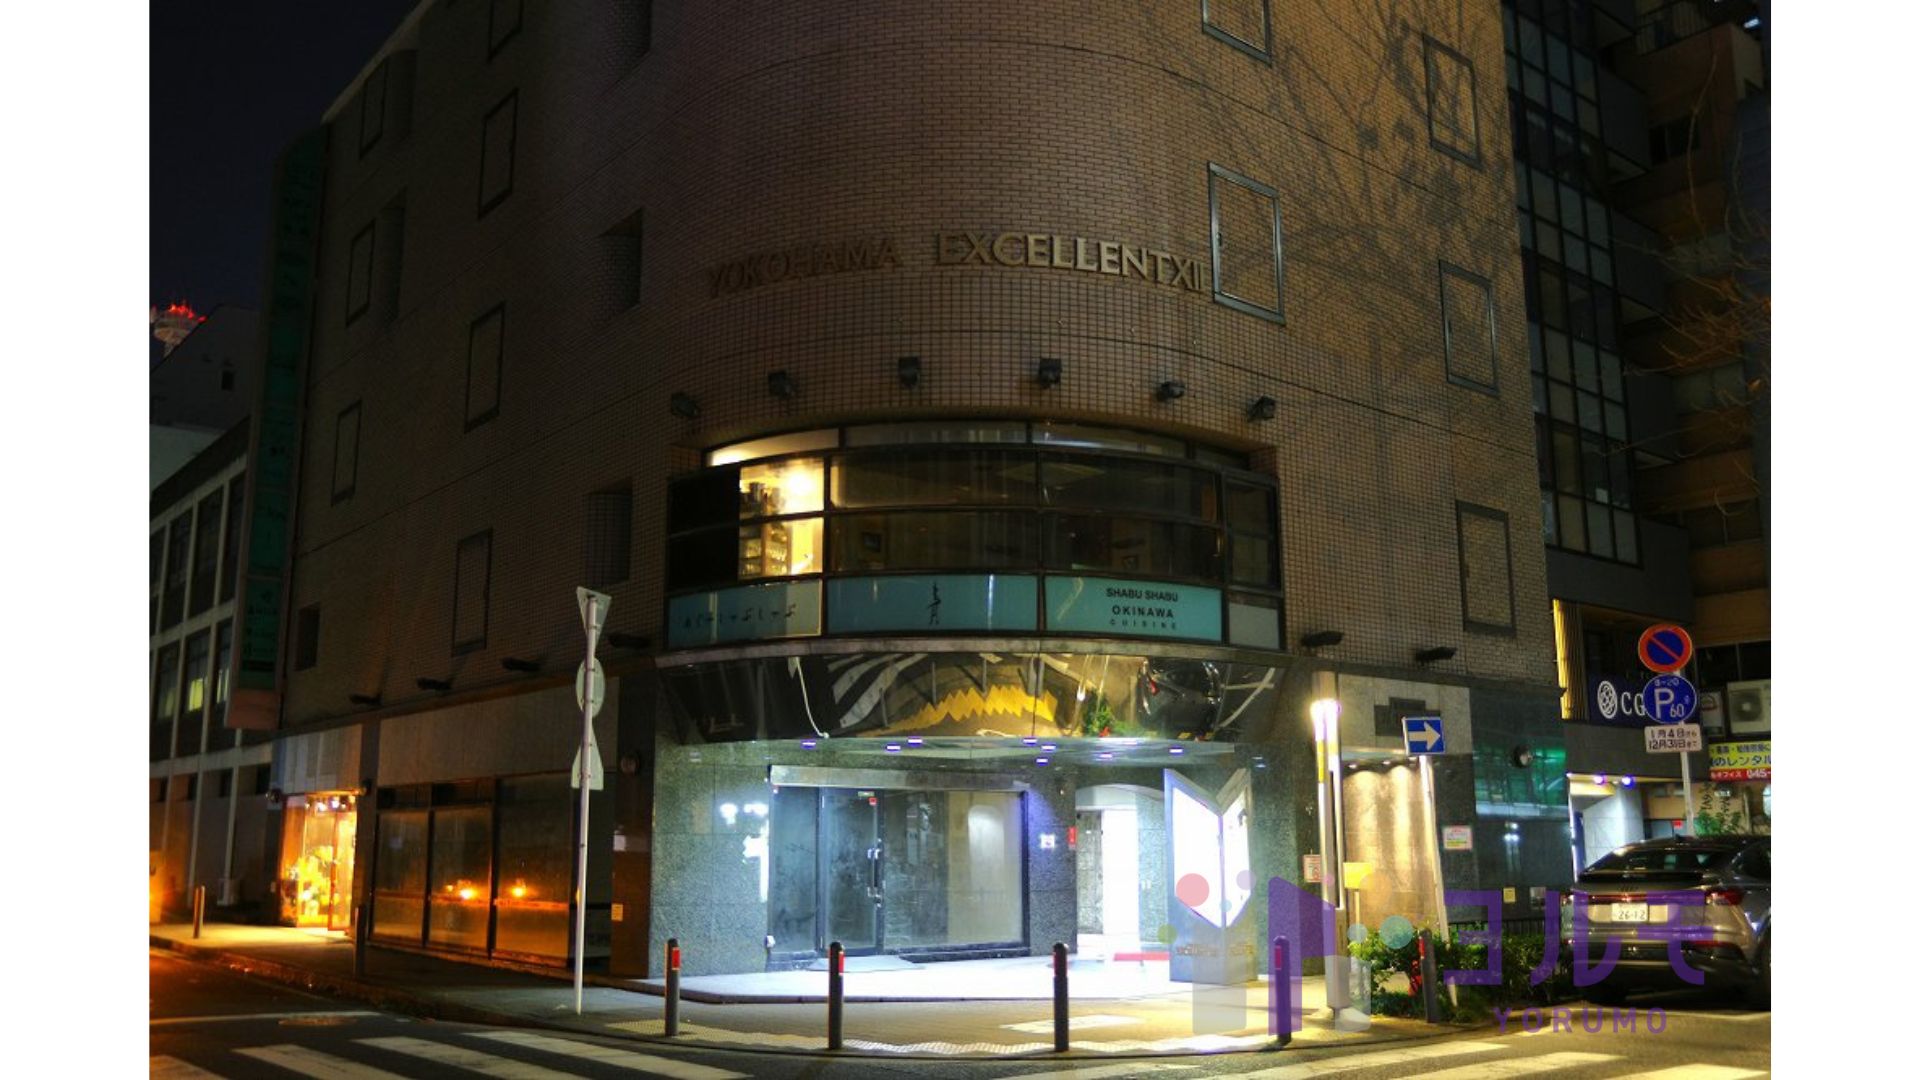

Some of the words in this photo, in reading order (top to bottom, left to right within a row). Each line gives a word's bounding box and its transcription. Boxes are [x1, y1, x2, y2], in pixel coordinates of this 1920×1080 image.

[707, 238, 901, 297] YOKOHAMA
[1106, 588, 1142, 599] SHABU
[1145, 590, 1178, 602] SHABU
[1112, 605, 1174, 618] OKINAWA
[1110, 619, 1176, 630] CUISINE
[1654, 688, 1675, 719] P
